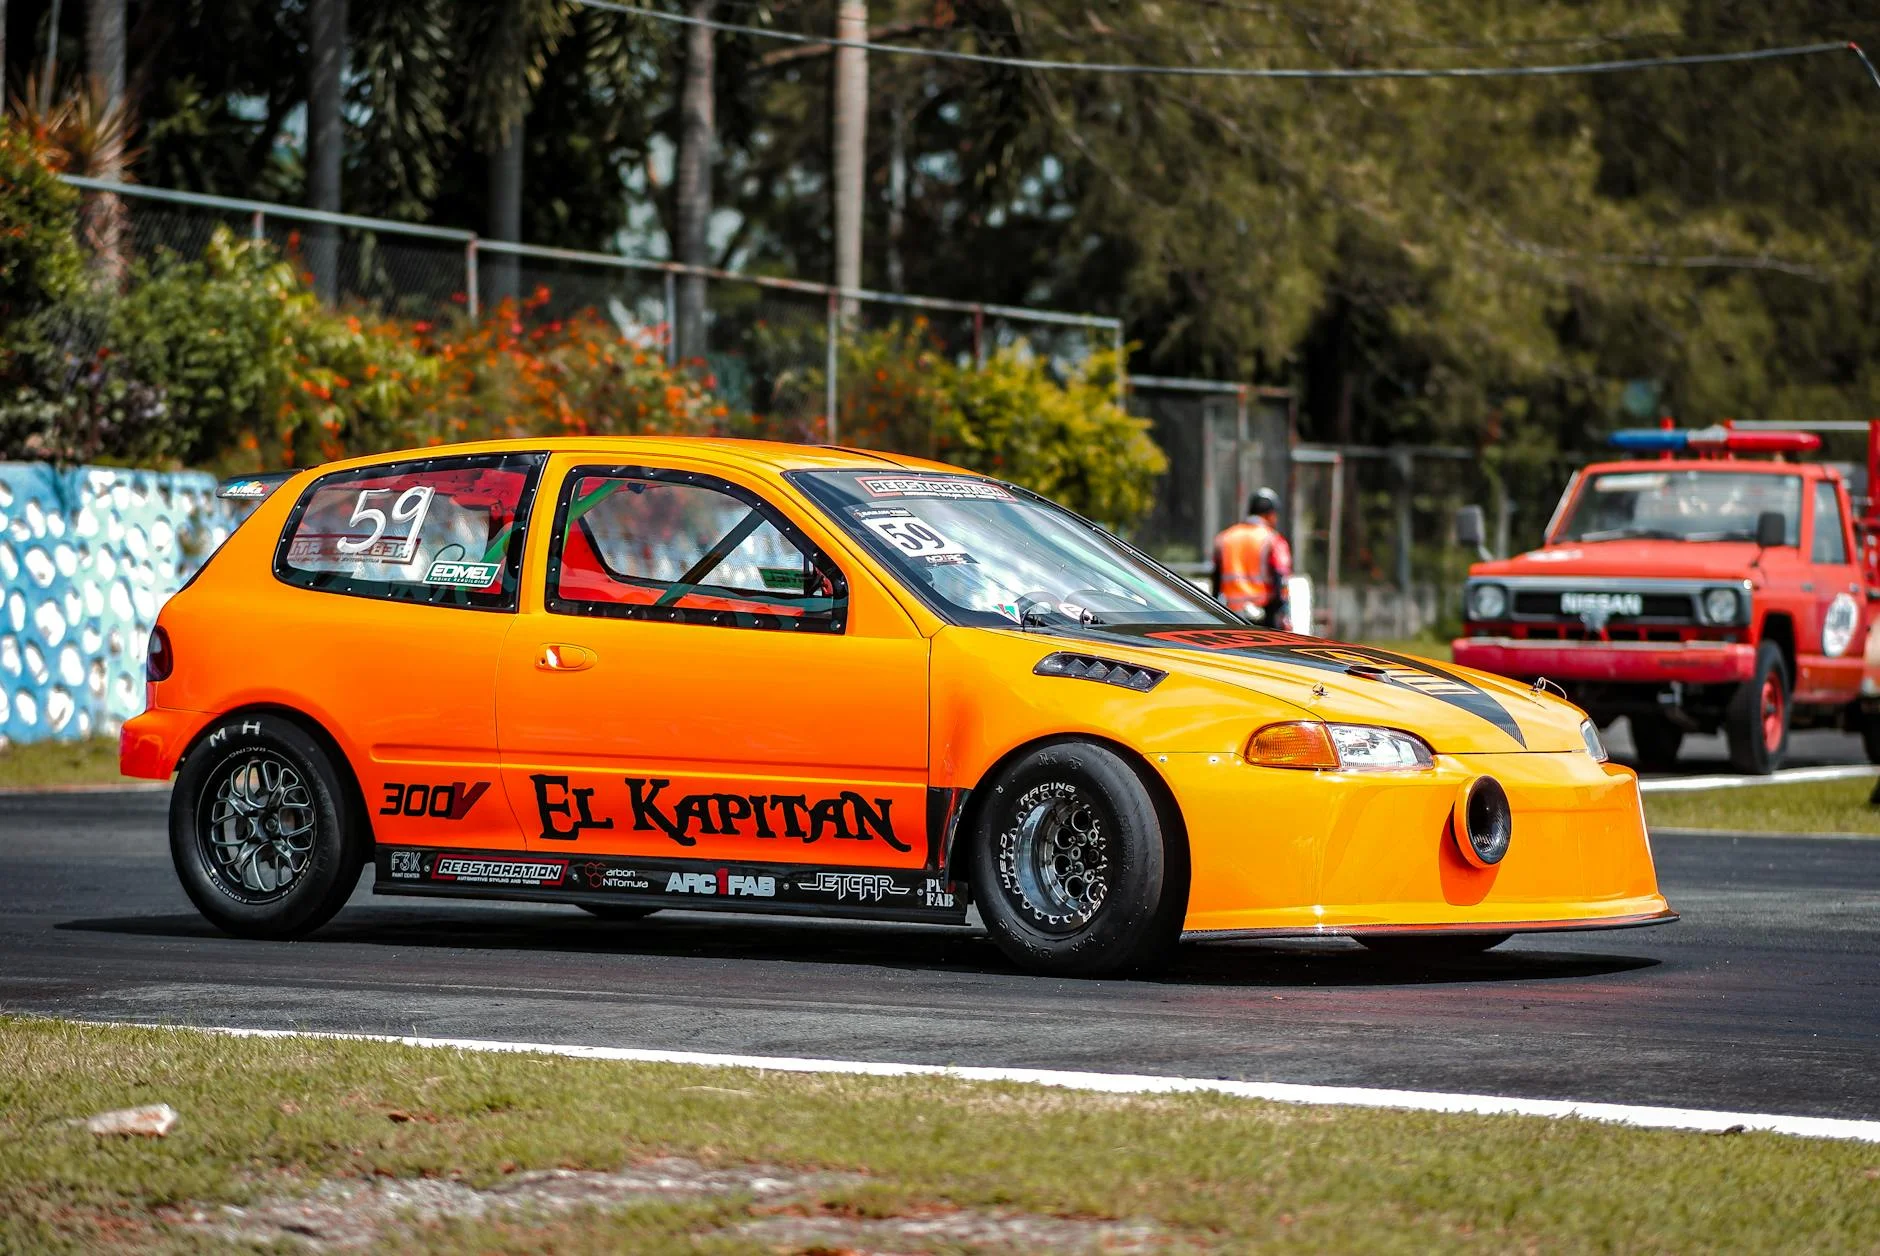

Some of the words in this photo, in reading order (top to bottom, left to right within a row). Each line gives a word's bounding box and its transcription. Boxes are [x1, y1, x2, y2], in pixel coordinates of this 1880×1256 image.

[866, 479, 1009, 499] REBSTORATION
[337, 486, 436, 553] 59
[879, 522, 945, 551] 59
[430, 564, 492, 580] EDMEL
[453, 577, 489, 585] REBUILDING
[1561, 592, 1643, 616] NISSAN
[209, 727, 227, 748] M
[242, 720, 261, 736] H
[379, 781, 492, 821] 300V
[1020, 782, 1076, 806] RACING
[391, 851, 421, 872] F3K
[438, 859, 563, 881] REBSTORATION
[999, 832, 1012, 890] WELD
[456, 875, 488, 883] AUTOMOTIVE
[797, 872, 911, 902] JETCAR
[926, 893, 954, 907] FAB
